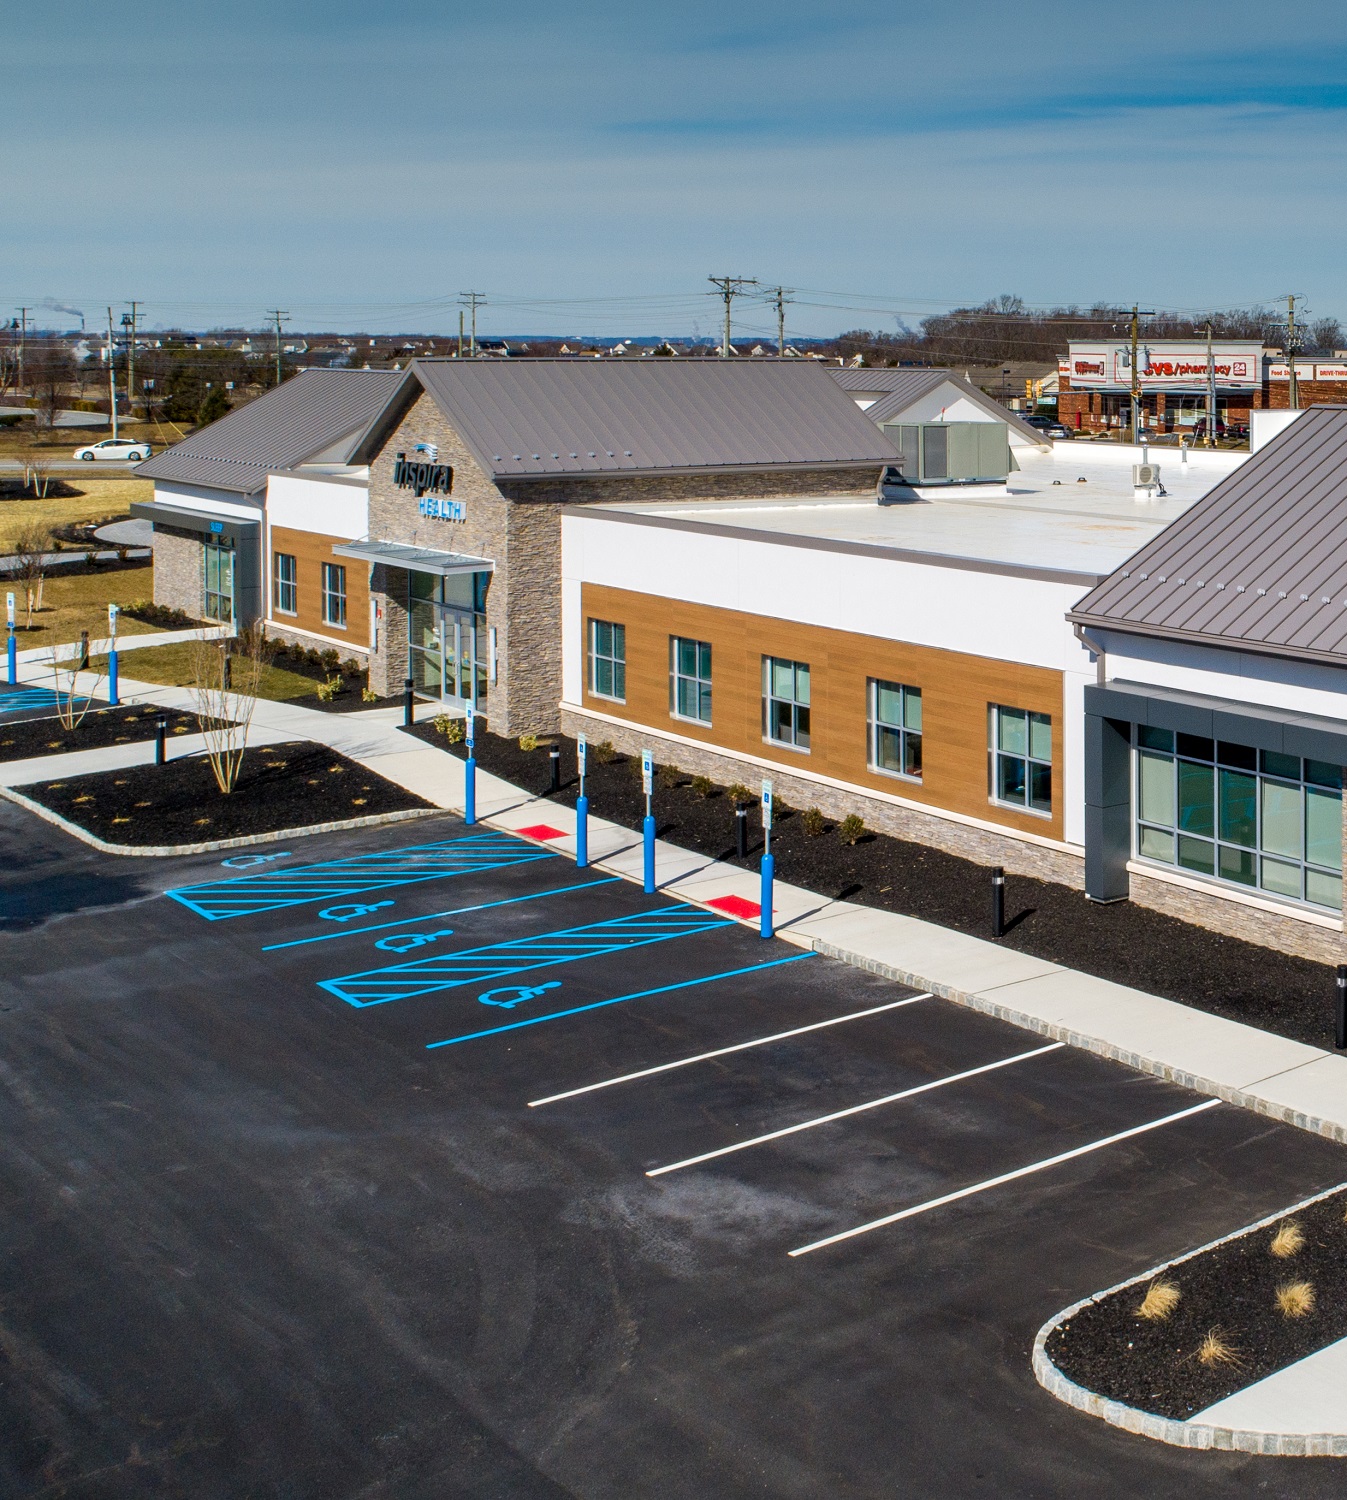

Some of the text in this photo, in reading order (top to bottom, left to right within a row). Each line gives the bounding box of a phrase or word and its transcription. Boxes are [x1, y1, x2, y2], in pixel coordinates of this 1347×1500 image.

[1234, 363, 1245, 371] 24
[394, 453, 451, 497] inspira
[419, 498, 465, 519] HEALTH
